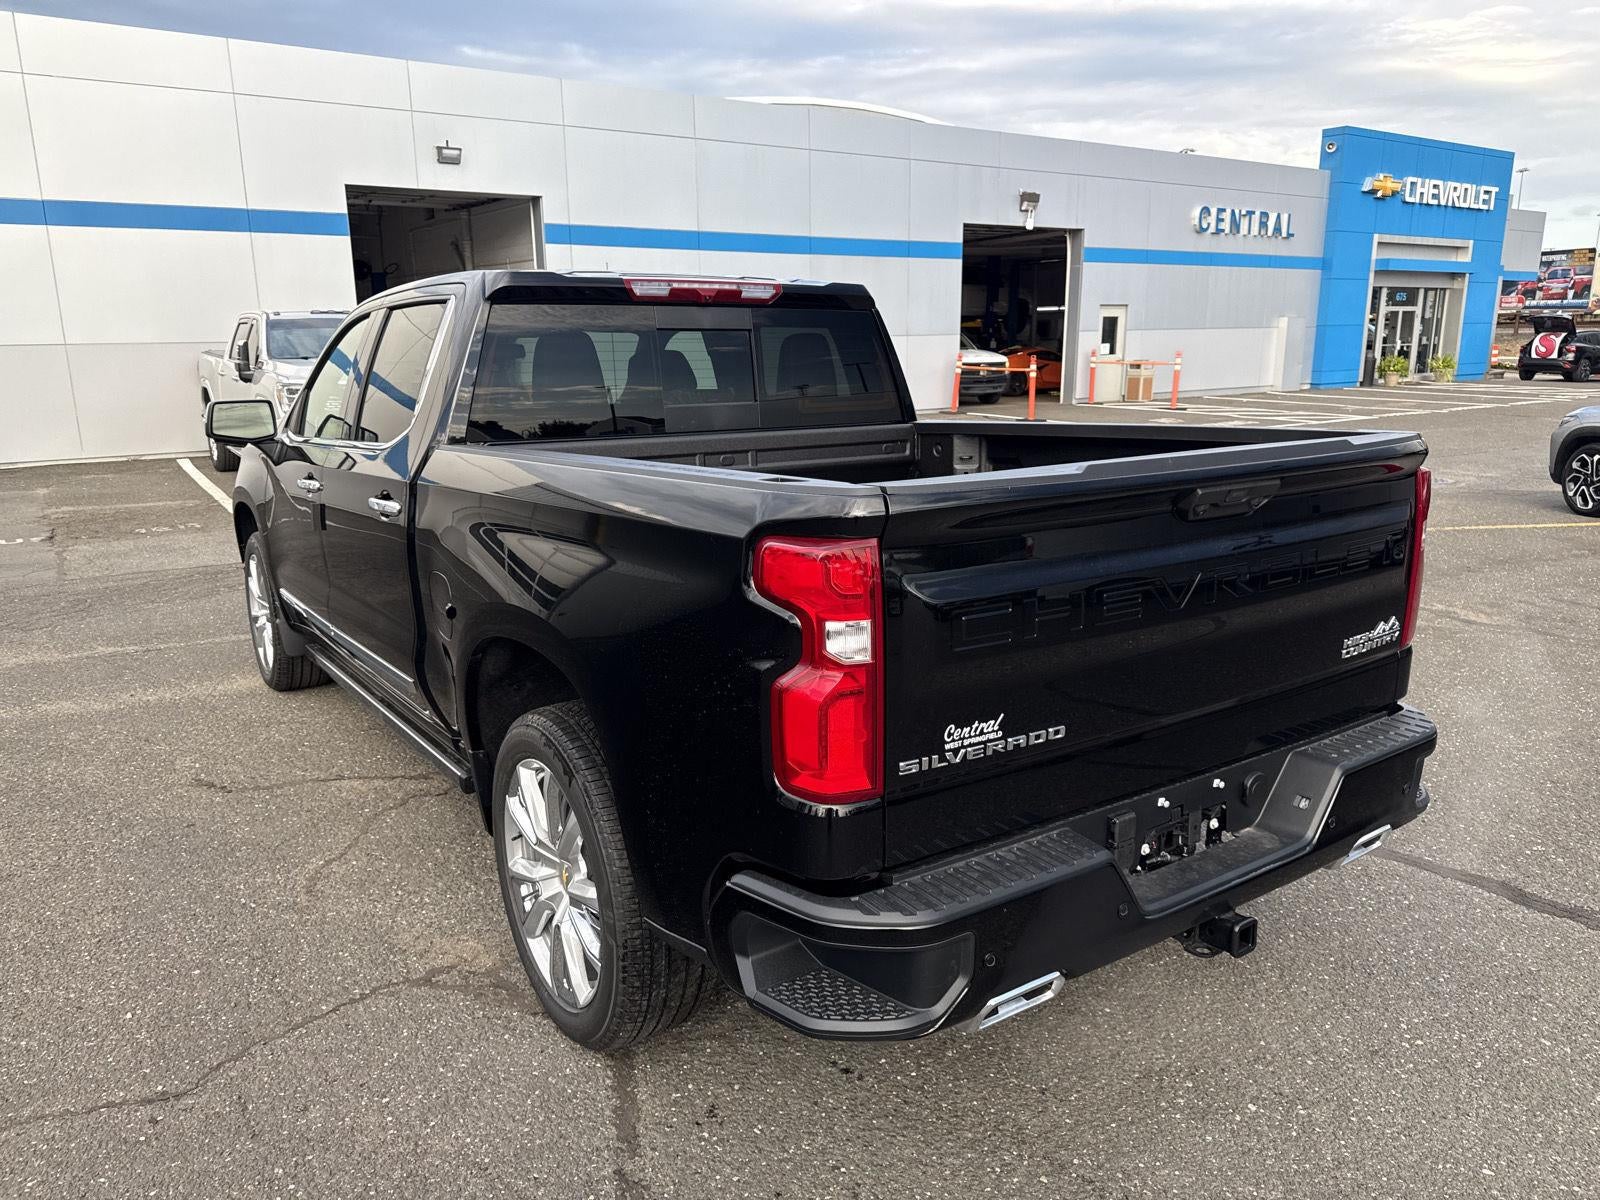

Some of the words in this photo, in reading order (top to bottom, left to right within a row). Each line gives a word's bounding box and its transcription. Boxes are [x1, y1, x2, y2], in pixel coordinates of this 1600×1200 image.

[1403, 176, 1499, 211] CHEVROLET
[1193, 205, 1295, 239] CENTRAL
[1396, 292, 1407, 301] 675
[1341, 631, 1400, 659] COUNTRY
[1343, 630, 1375, 649] HIGH
[943, 713, 1005, 743] Central
[944, 739, 963, 751] WEST
[963, 730, 1003, 746] SPRINGFIELD
[898, 725, 1067, 776] SILVERADO
